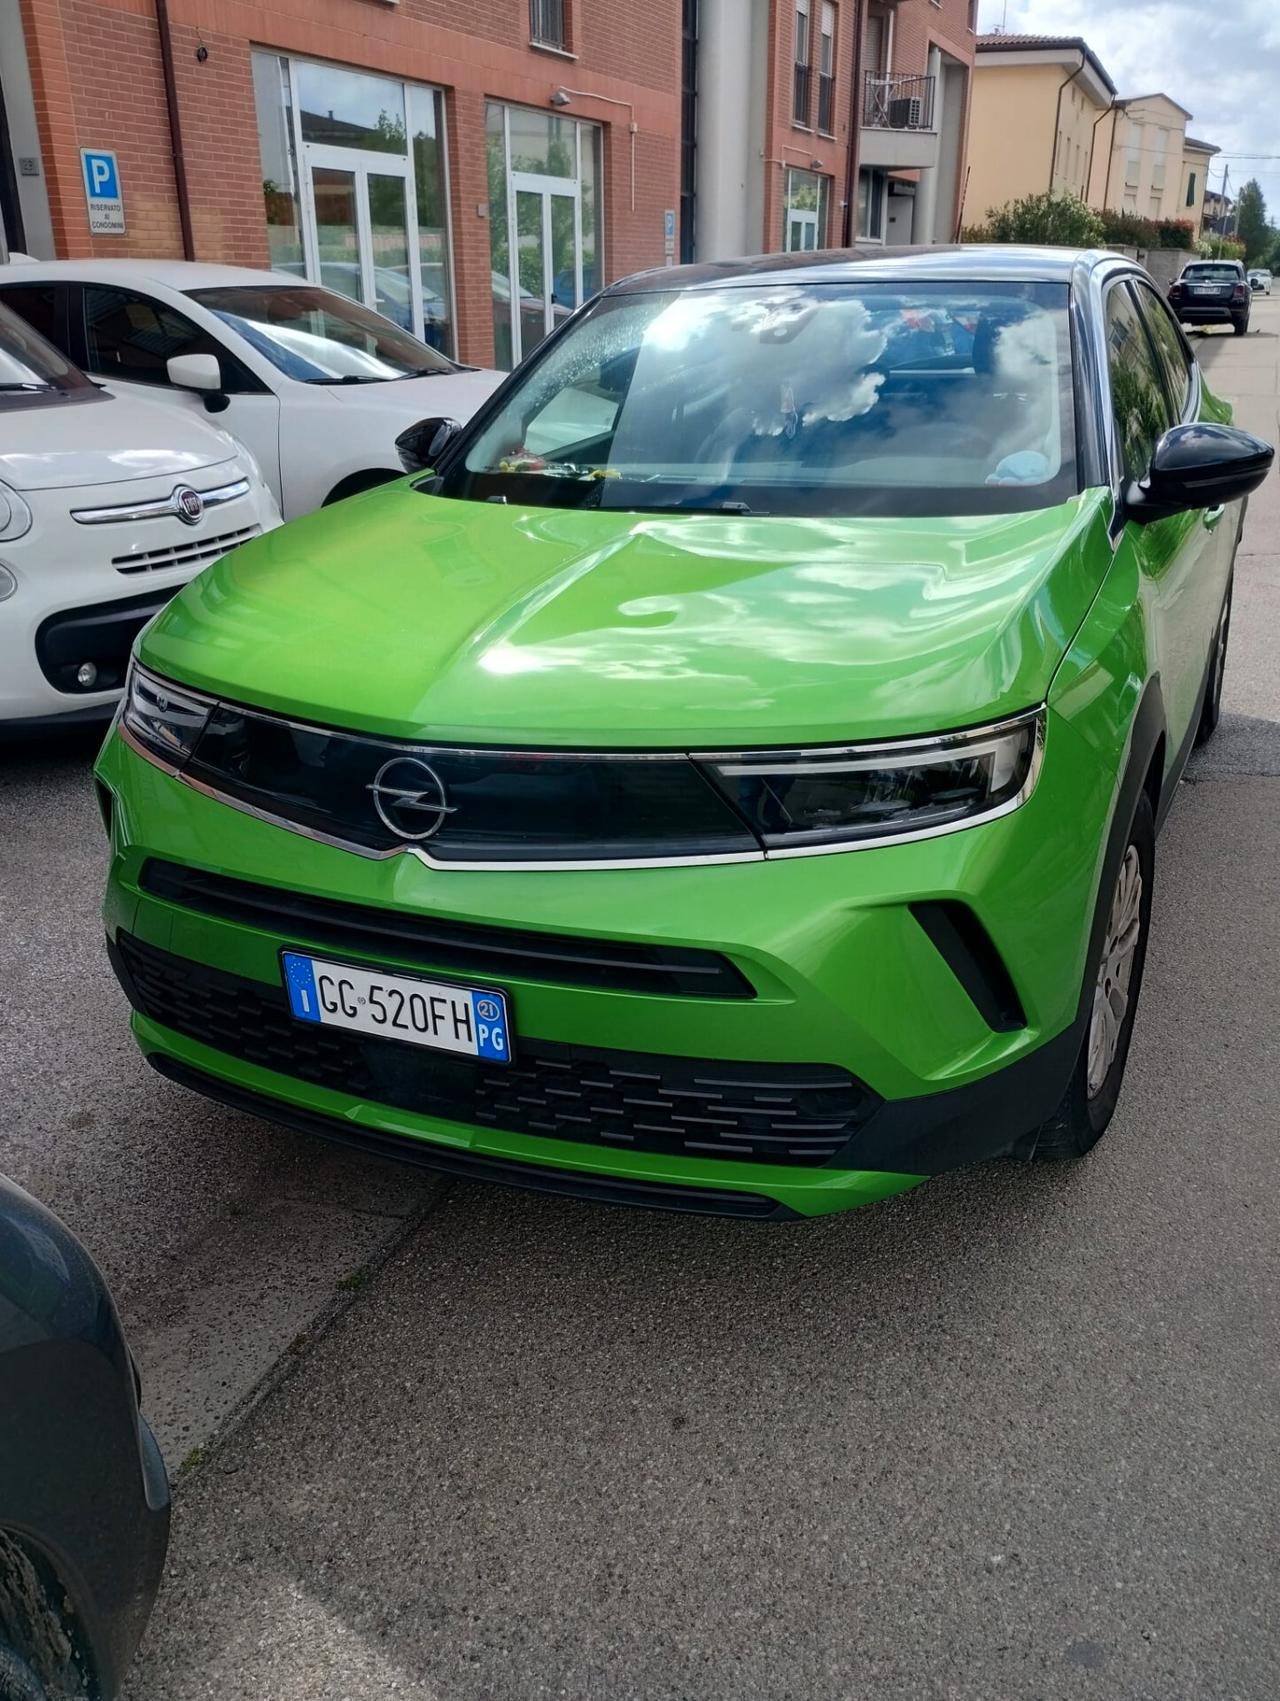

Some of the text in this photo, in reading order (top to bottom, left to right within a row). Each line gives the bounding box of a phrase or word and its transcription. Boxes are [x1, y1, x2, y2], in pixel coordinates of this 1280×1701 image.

[90, 158, 110, 194] P
[300, 989, 310, 1013] I
[318, 975, 473, 1043] GG 520FH
[478, 1003, 494, 1018] 21
[477, 1023, 504, 1051] PG
